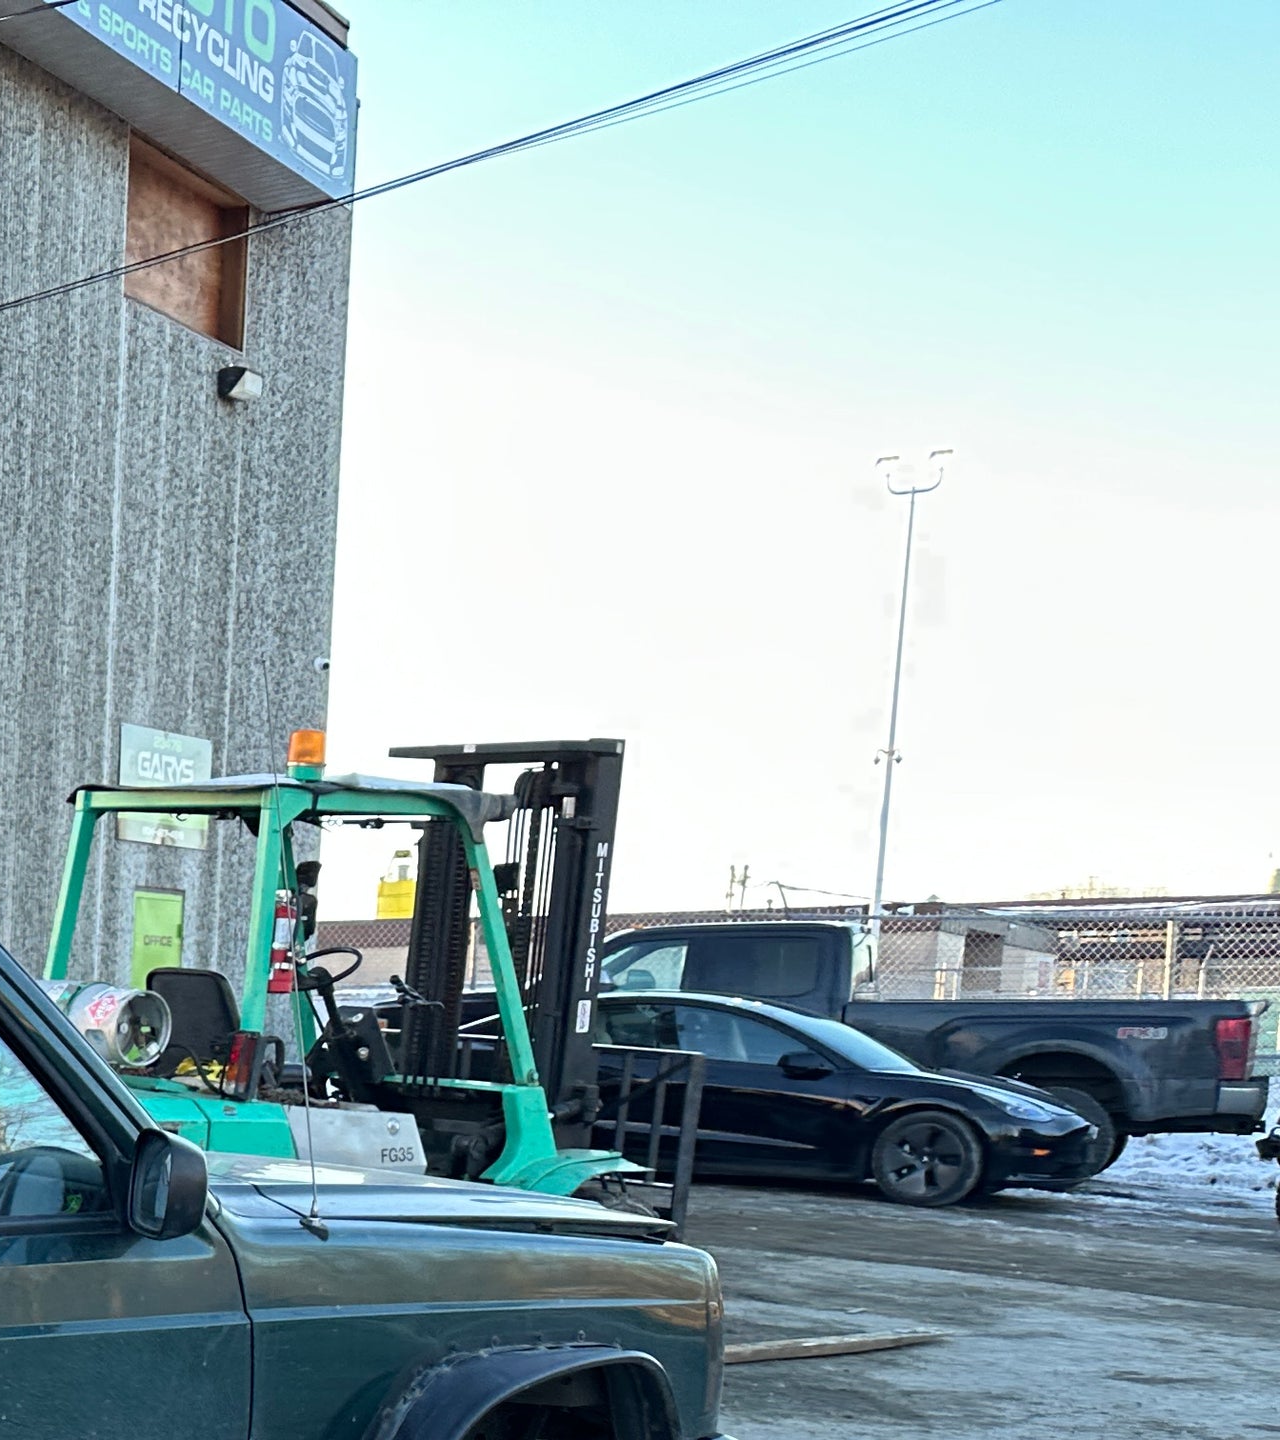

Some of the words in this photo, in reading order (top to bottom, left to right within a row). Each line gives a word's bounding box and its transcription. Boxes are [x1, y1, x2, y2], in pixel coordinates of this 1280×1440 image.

[98, 2, 172, 74] SPORTS
[180, 59, 215, 104] CAR
[220, 87, 273, 142] PARTS
[137, 748, 195, 783] GARYS
[584, 842, 608, 993] MITSUBISHI
[143, 934, 173, 948] OFFICE
[381, 1147, 414, 1164] FG35
